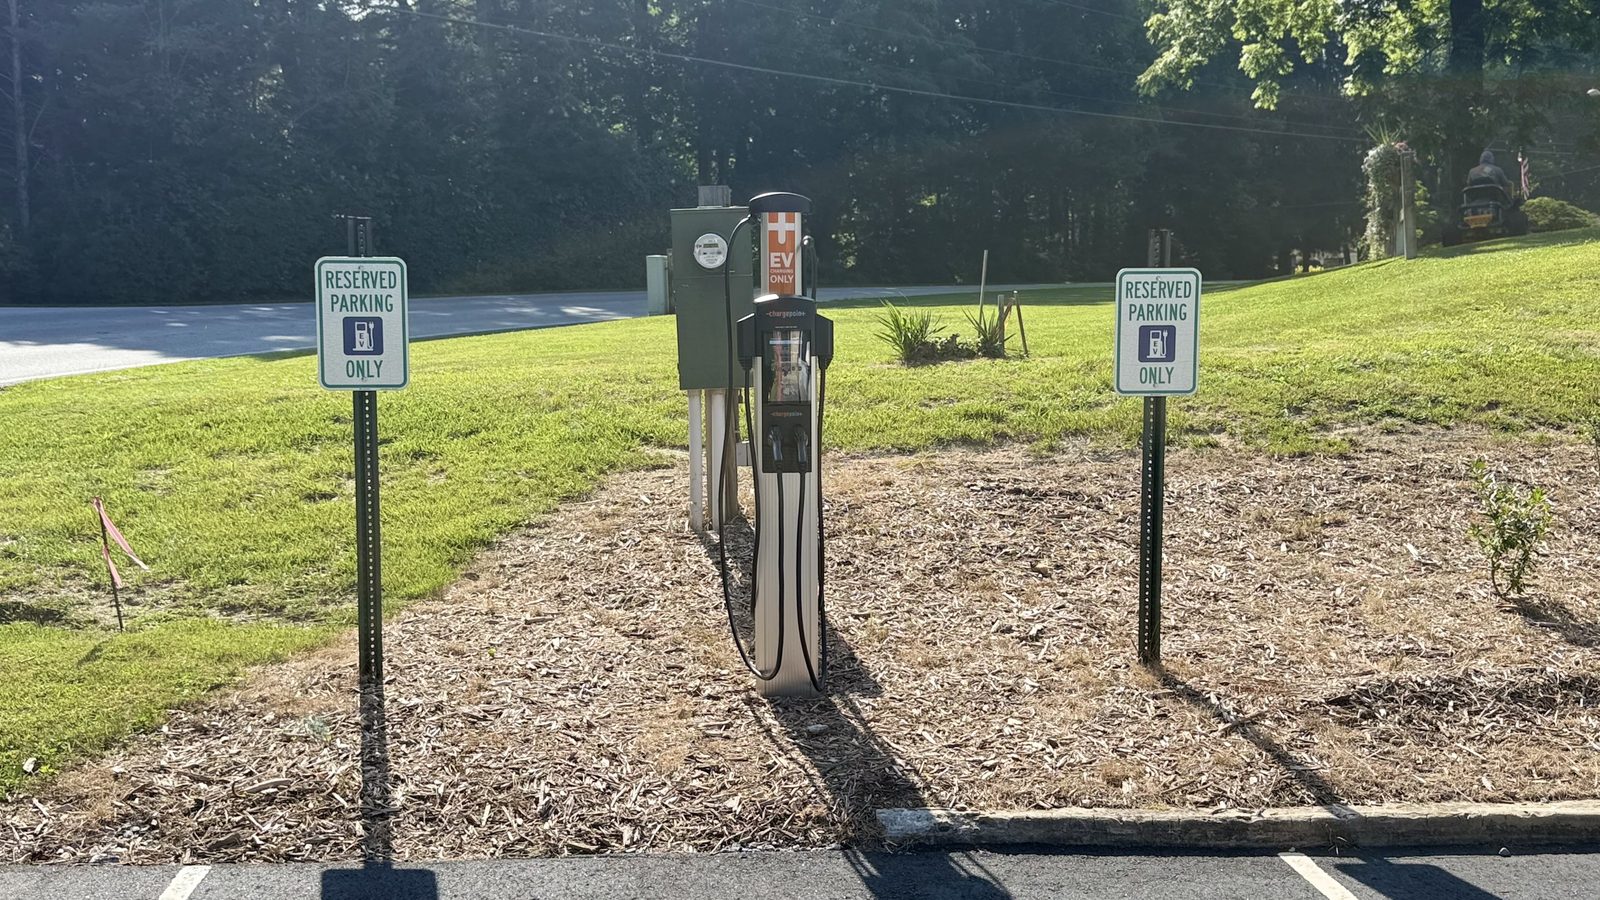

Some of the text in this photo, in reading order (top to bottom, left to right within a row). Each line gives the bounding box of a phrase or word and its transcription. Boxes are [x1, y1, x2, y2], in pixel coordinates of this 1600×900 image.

[770, 252, 794, 268] EV
[325, 270, 397, 289] RESERVED
[770, 275, 794, 283] ONLY
[1125, 281, 1192, 299] RESERVED
[330, 294, 393, 313] PARKING
[1128, 303, 1187, 321] PARKING
[345, 360, 383, 378] ONLY
[1140, 367, 1174, 384] ONLY
